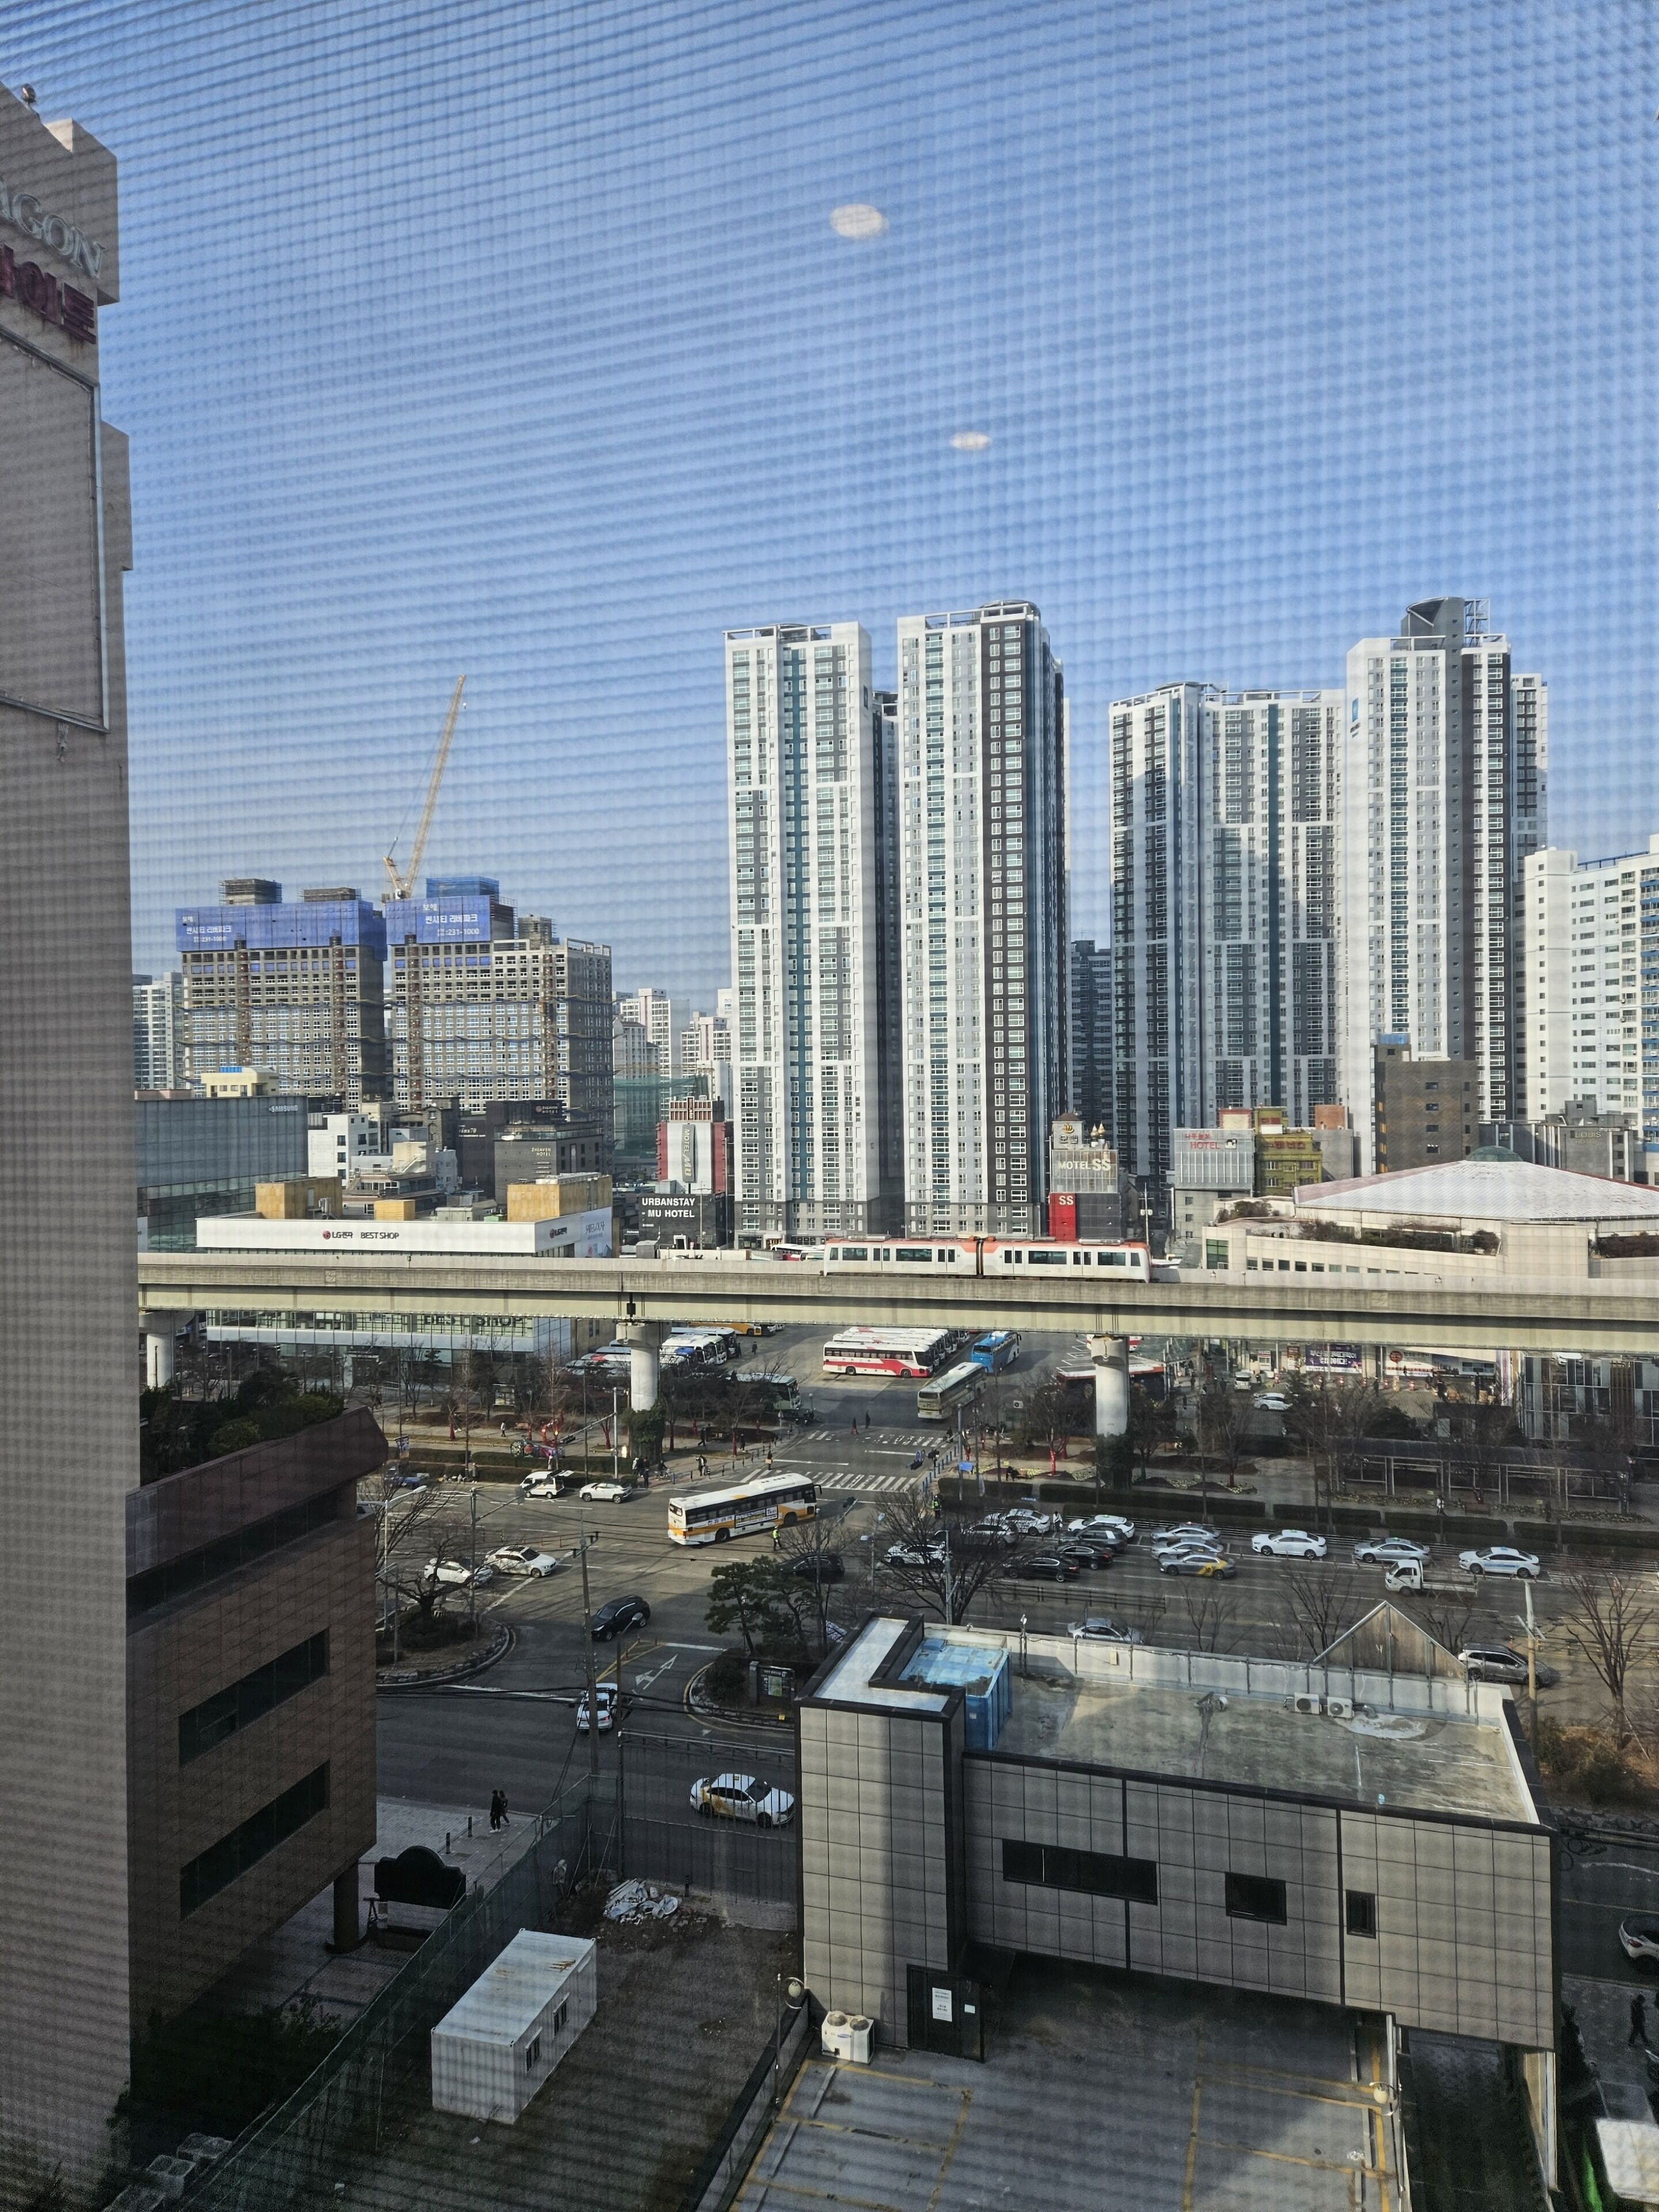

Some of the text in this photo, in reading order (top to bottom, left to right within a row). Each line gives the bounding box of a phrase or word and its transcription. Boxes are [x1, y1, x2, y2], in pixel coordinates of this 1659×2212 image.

[1190, 1141, 1221, 1149] HOTEL
[1058, 1158, 1112, 1171] MOTEL SS
[642, 1198, 695, 1206] URBANSTAY
[1059, 1195, 1074, 1205] SS
[665, 1210, 695, 1218] HOTEL
